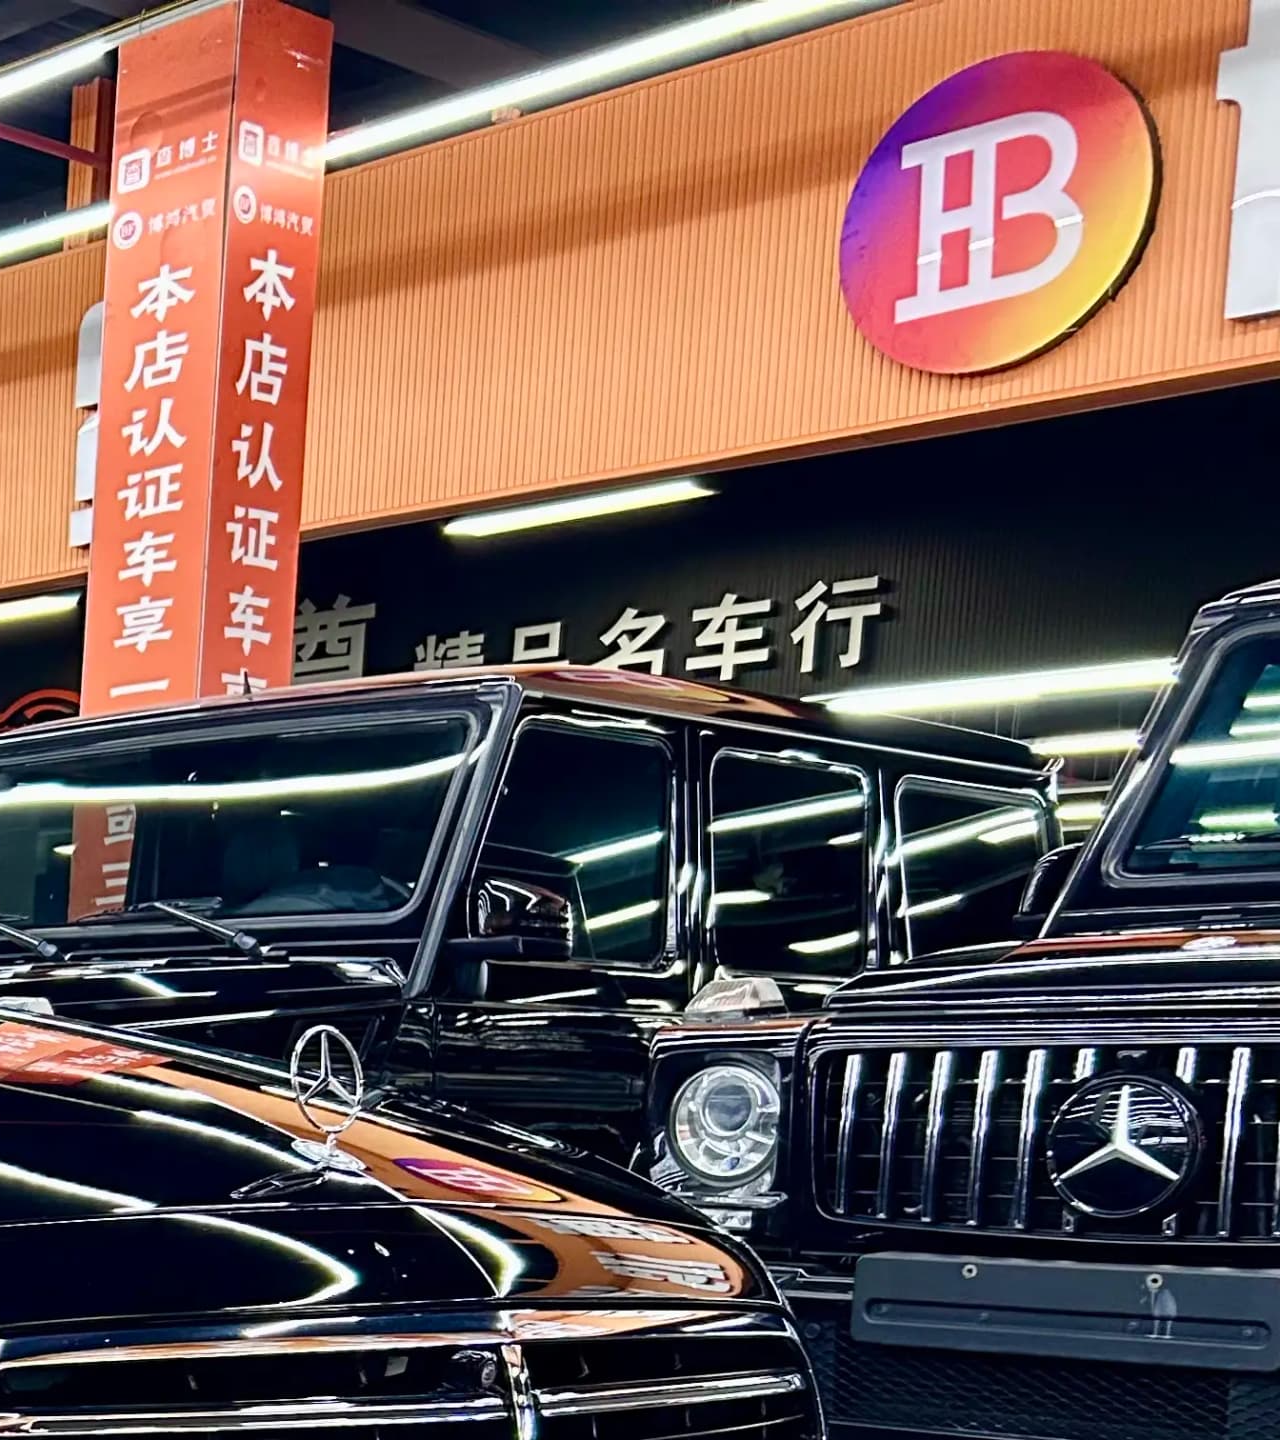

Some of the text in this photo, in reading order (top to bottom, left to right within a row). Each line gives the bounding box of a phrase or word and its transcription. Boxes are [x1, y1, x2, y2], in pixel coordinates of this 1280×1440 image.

[110, 264, 195, 697] 本店认证车享一
